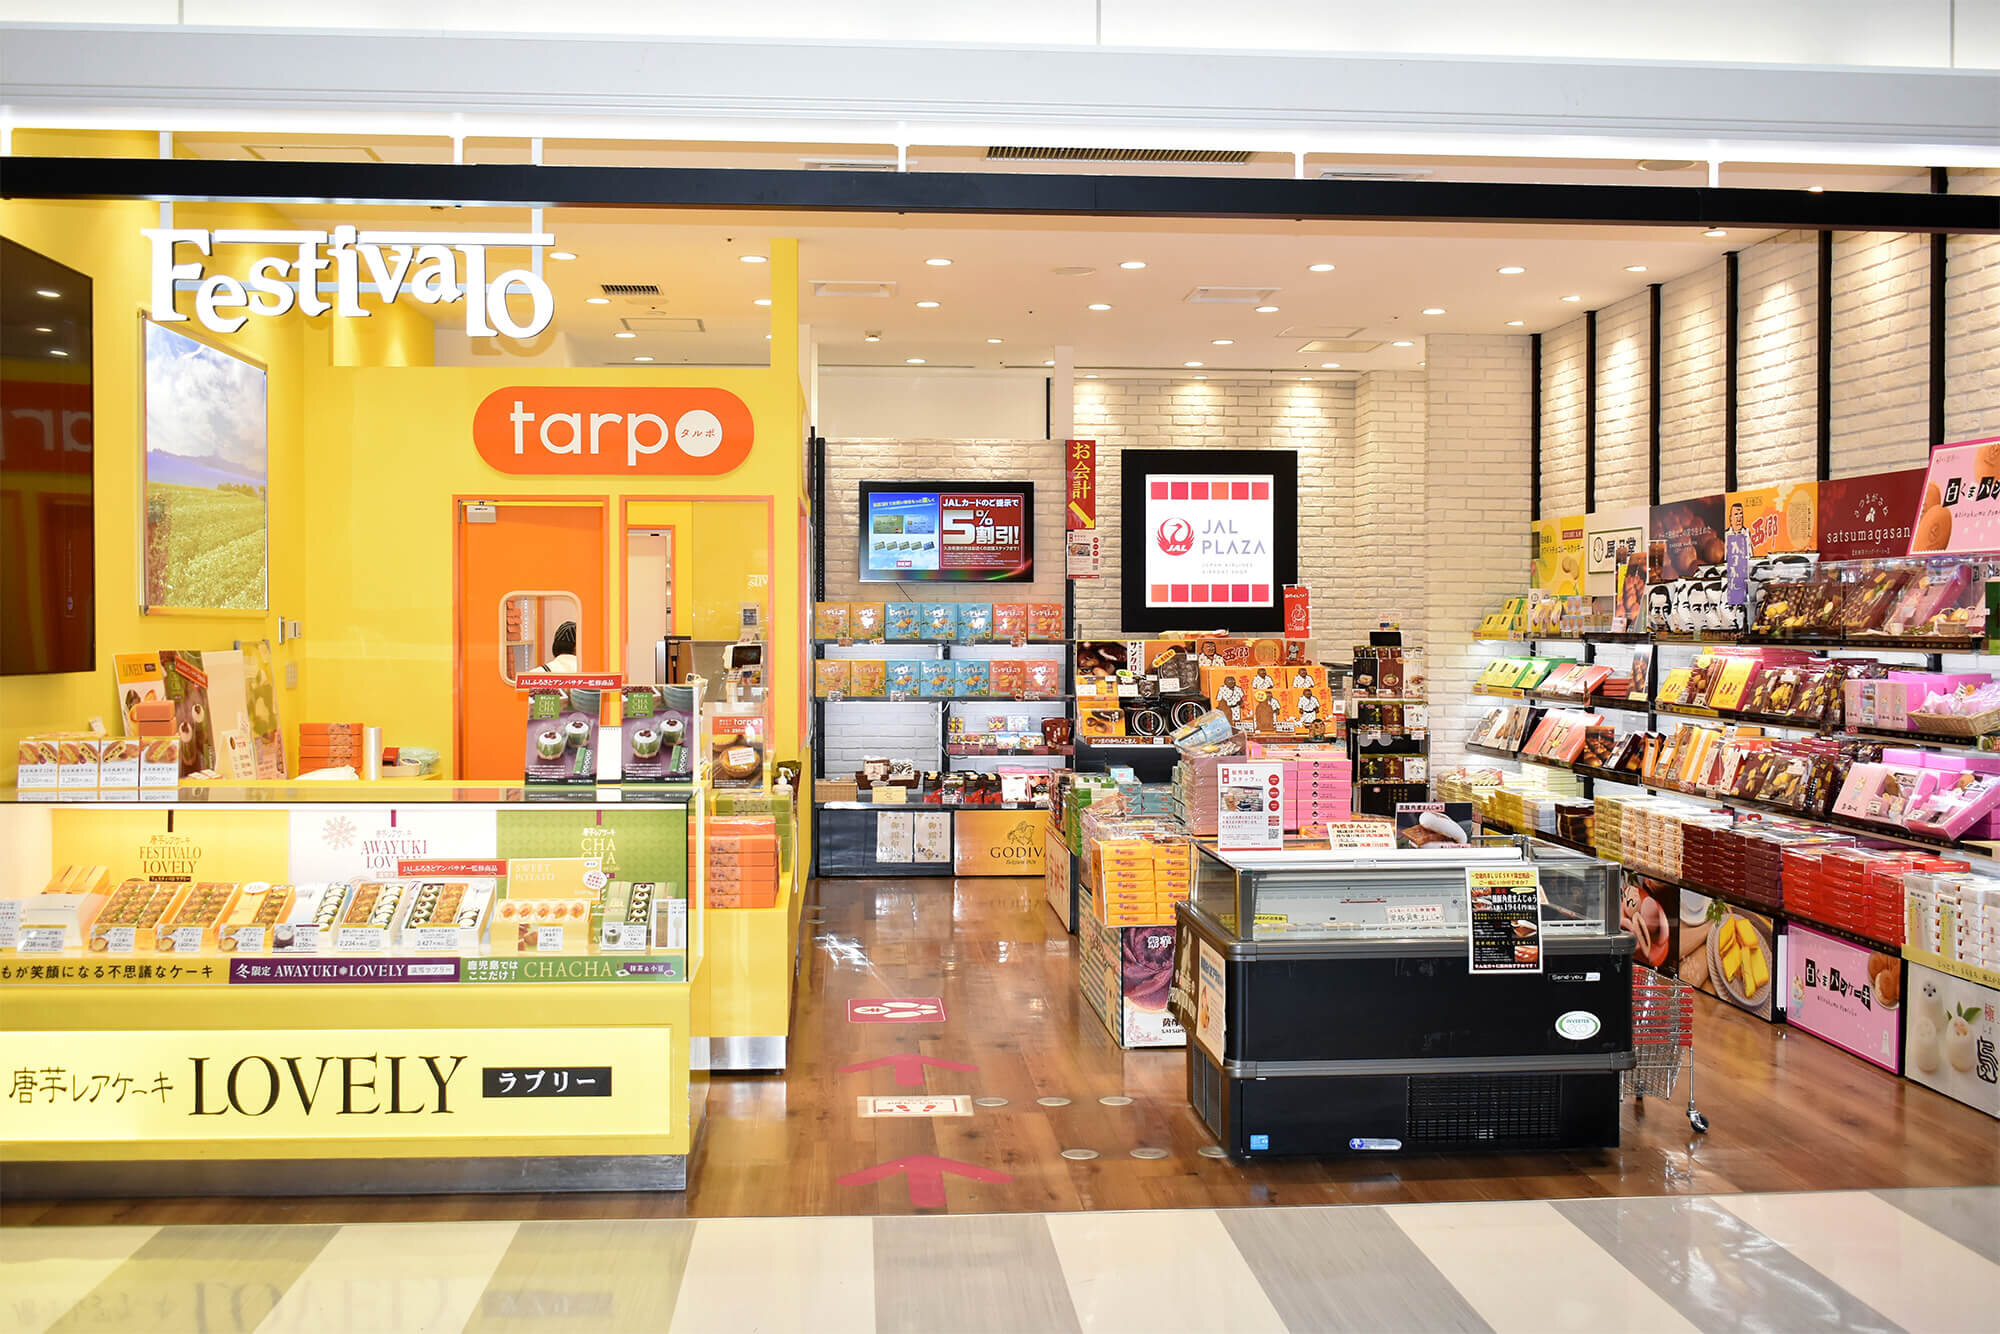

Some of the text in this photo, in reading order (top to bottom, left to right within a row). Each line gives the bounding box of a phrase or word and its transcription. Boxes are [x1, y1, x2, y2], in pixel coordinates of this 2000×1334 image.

[141, 224, 555, 338] Festivalo
[680, 428, 716, 439] タルポ
[1072, 442, 1092, 500] お会計
[943, 499, 1019, 507] JALカードのご提示で
[1202, 520, 1238, 534] JAL
[1826, 526, 1911, 544] satsumagasan
[1167, 544, 1187, 552] JAL
[1202, 540, 1266, 555] PLAZA
[361, 840, 427, 855] AWAYUKI
[581, 838, 617, 851] CHA
[139, 846, 202, 859] FESTIVALO
[143, 861, 197, 874] LOVELY
[1, 964, 214, 980] もが笑顔になる不思議なケーキ
[236, 963, 272, 979] 冬限定
[274, 964, 338, 977] AWAYUKI
[349, 964, 406, 977] LOVELY
[467, 960, 518, 970] 鹿児島では
[523, 961, 613, 978] CHACHA
[8, 1066, 174, 1104] 唐芋レアケーキ
[187, 1055, 468, 1116] LOVELY
[497, 1069, 597, 1094] ラブリー
